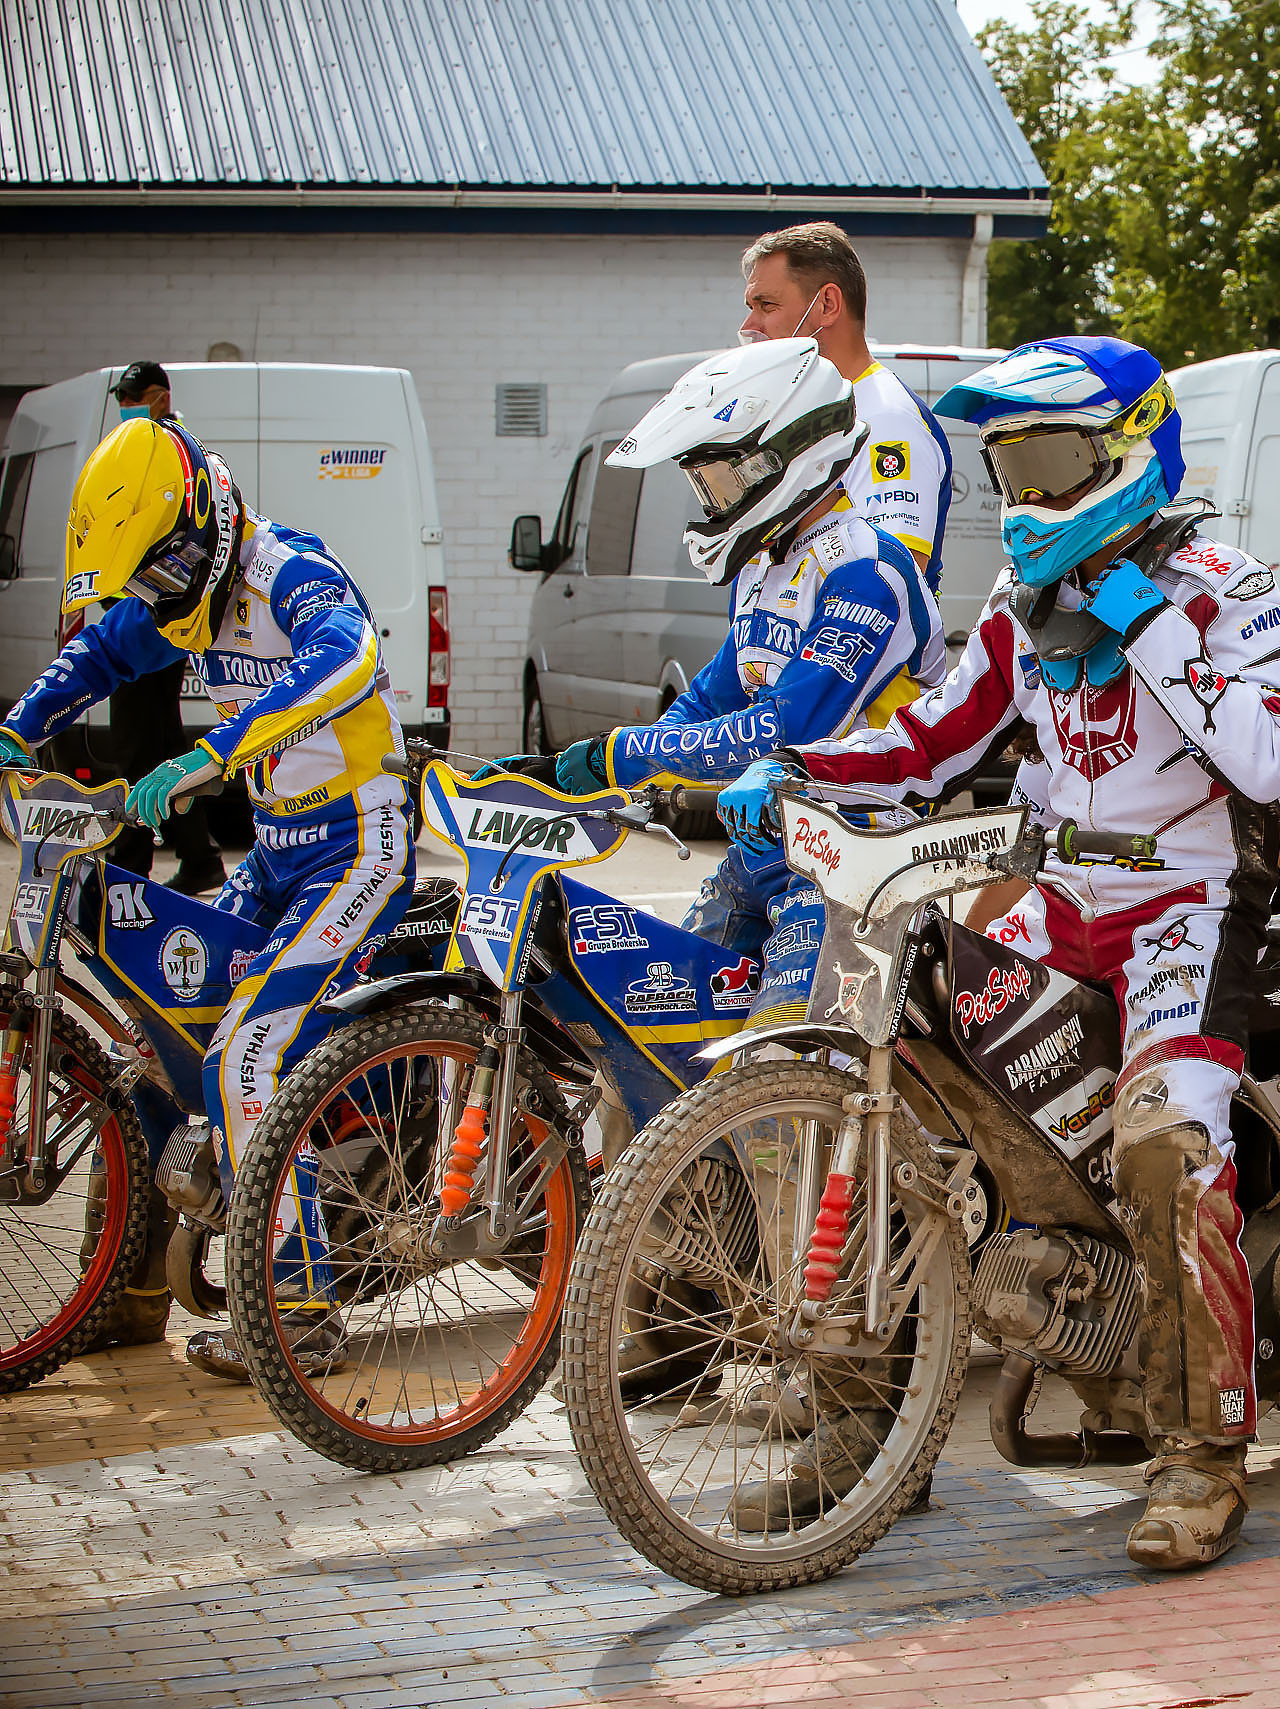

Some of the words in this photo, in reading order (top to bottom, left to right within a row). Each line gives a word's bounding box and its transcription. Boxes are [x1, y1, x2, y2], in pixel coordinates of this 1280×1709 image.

[882, 469, 900, 478] PZM
[884, 490, 919, 504] PBDI
[208, 494, 230, 585] VESTHAL
[625, 711, 777, 758] NICOLAUS
[705, 743, 780, 768] BANK
[23, 804, 91, 841] LAVOR
[467, 807, 576, 854] LAVOR
[792, 817, 842, 877] PitStop
[336, 867, 391, 930] VESTHAL
[463, 895, 519, 928] FST
[119, 919, 145, 929] racing
[569, 906, 638, 940] FST
[587, 940, 611, 952] Grupa
[612, 938, 648, 949] Brokerska
[625, 989, 696, 1004] RAFBACH
[889, 977, 909, 1038] MALINIAK
[904, 943, 918, 977] DSGN
[955, 959, 1031, 1040] PitStop
[239, 1022, 272, 1098] VESTHAL
[1219, 1388, 1245, 1403] MALI
